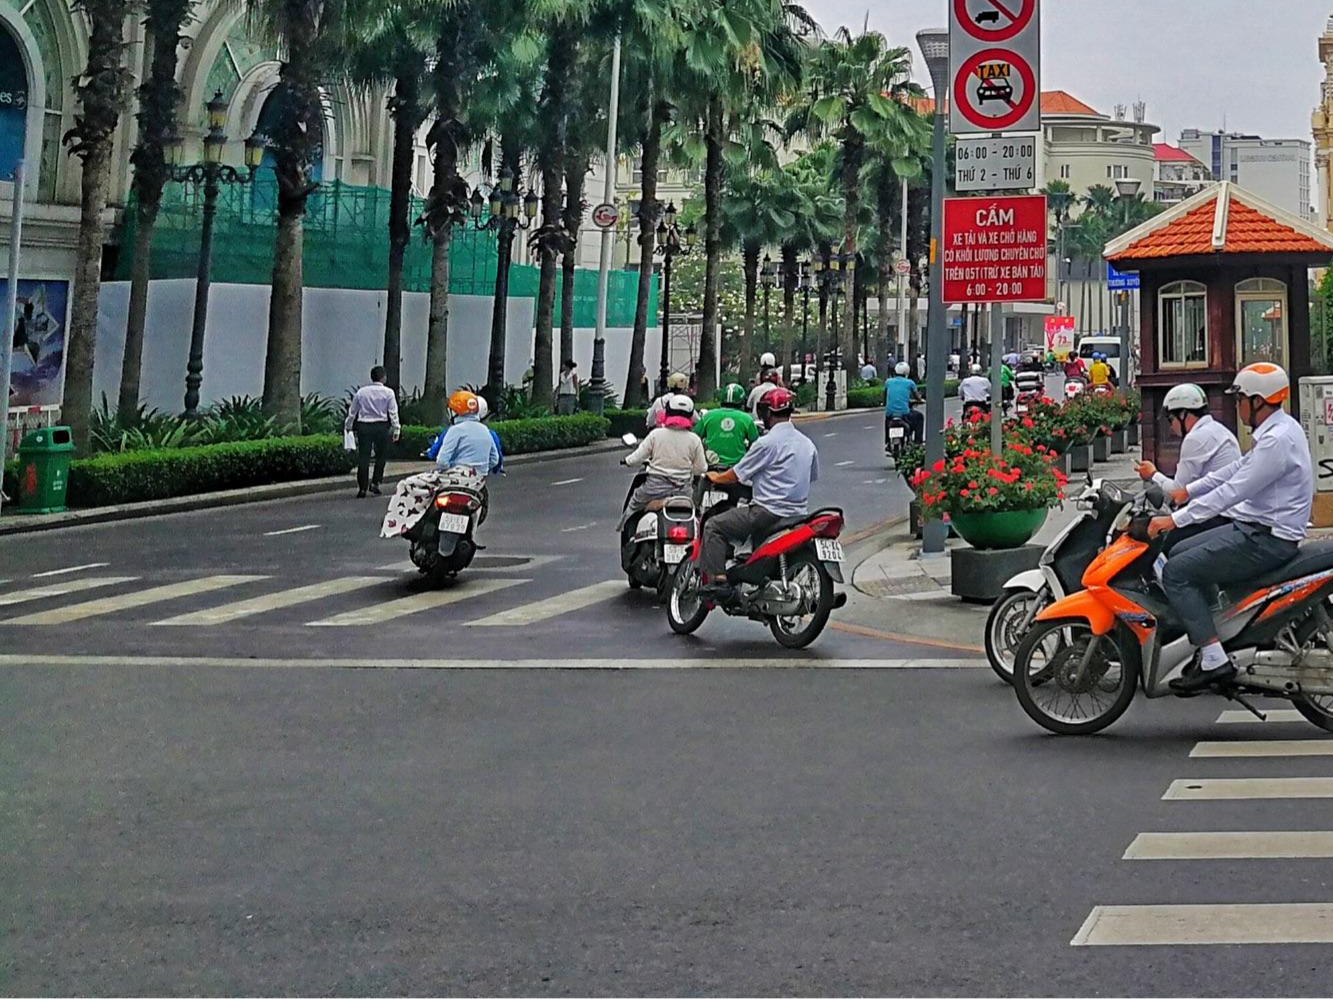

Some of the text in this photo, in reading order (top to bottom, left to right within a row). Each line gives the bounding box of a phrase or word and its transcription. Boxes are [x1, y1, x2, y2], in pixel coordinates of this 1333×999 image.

[978, 63, 1010, 79] TAXI
[958, 146, 987, 160] 06:00
[1002, 145, 1032, 158] 20:00
[958, 165, 976, 182] THỨ
[980, 168, 986, 181] 2
[1003, 164, 1021, 180] THỨ
[1026, 167, 1032, 180] 6
[976, 203, 1014, 226] CẤM
[953, 233, 963, 245] XE
[964, 230, 976, 245] TẢI
[977, 230, 987, 245] VÀ
[988, 232, 999, 244] XE
[1017, 229, 1037, 243] HÀNG
[945, 266, 964, 280] TRÊN
[1000, 266, 1011, 279] XE
